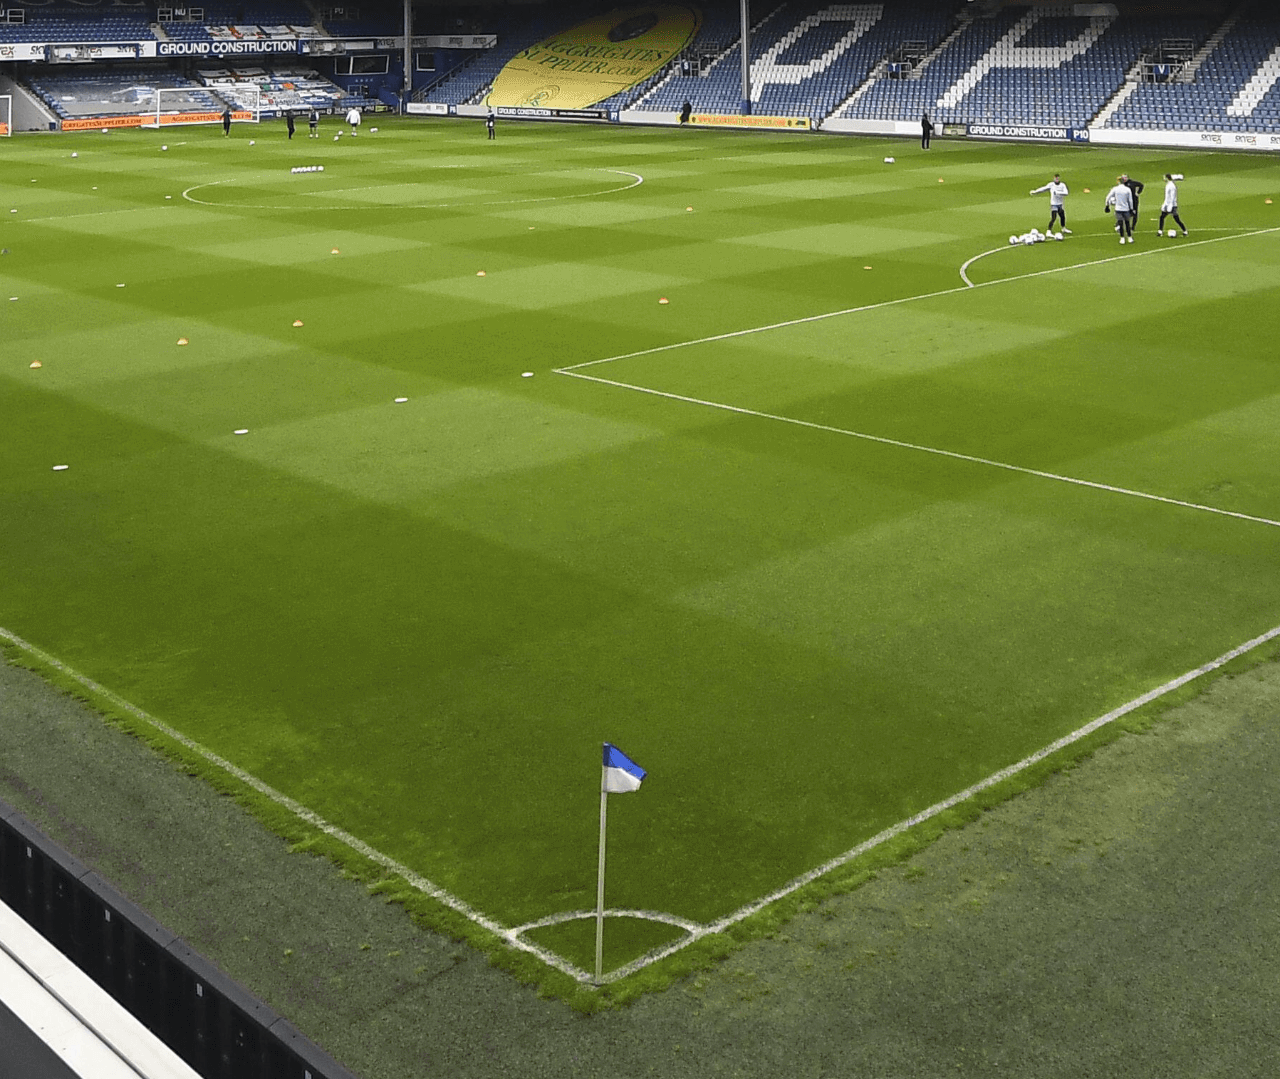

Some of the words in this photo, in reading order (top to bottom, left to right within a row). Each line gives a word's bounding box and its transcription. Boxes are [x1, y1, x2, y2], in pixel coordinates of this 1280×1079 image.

[159, 42, 211, 55] GROUND
[211, 40, 297, 54] CONSTRUCTION
[970, 125, 1003, 136] GROUND
[1004, 126, 1067, 139] CONSTRUCTION
[1073, 129, 1089, 139] P10
